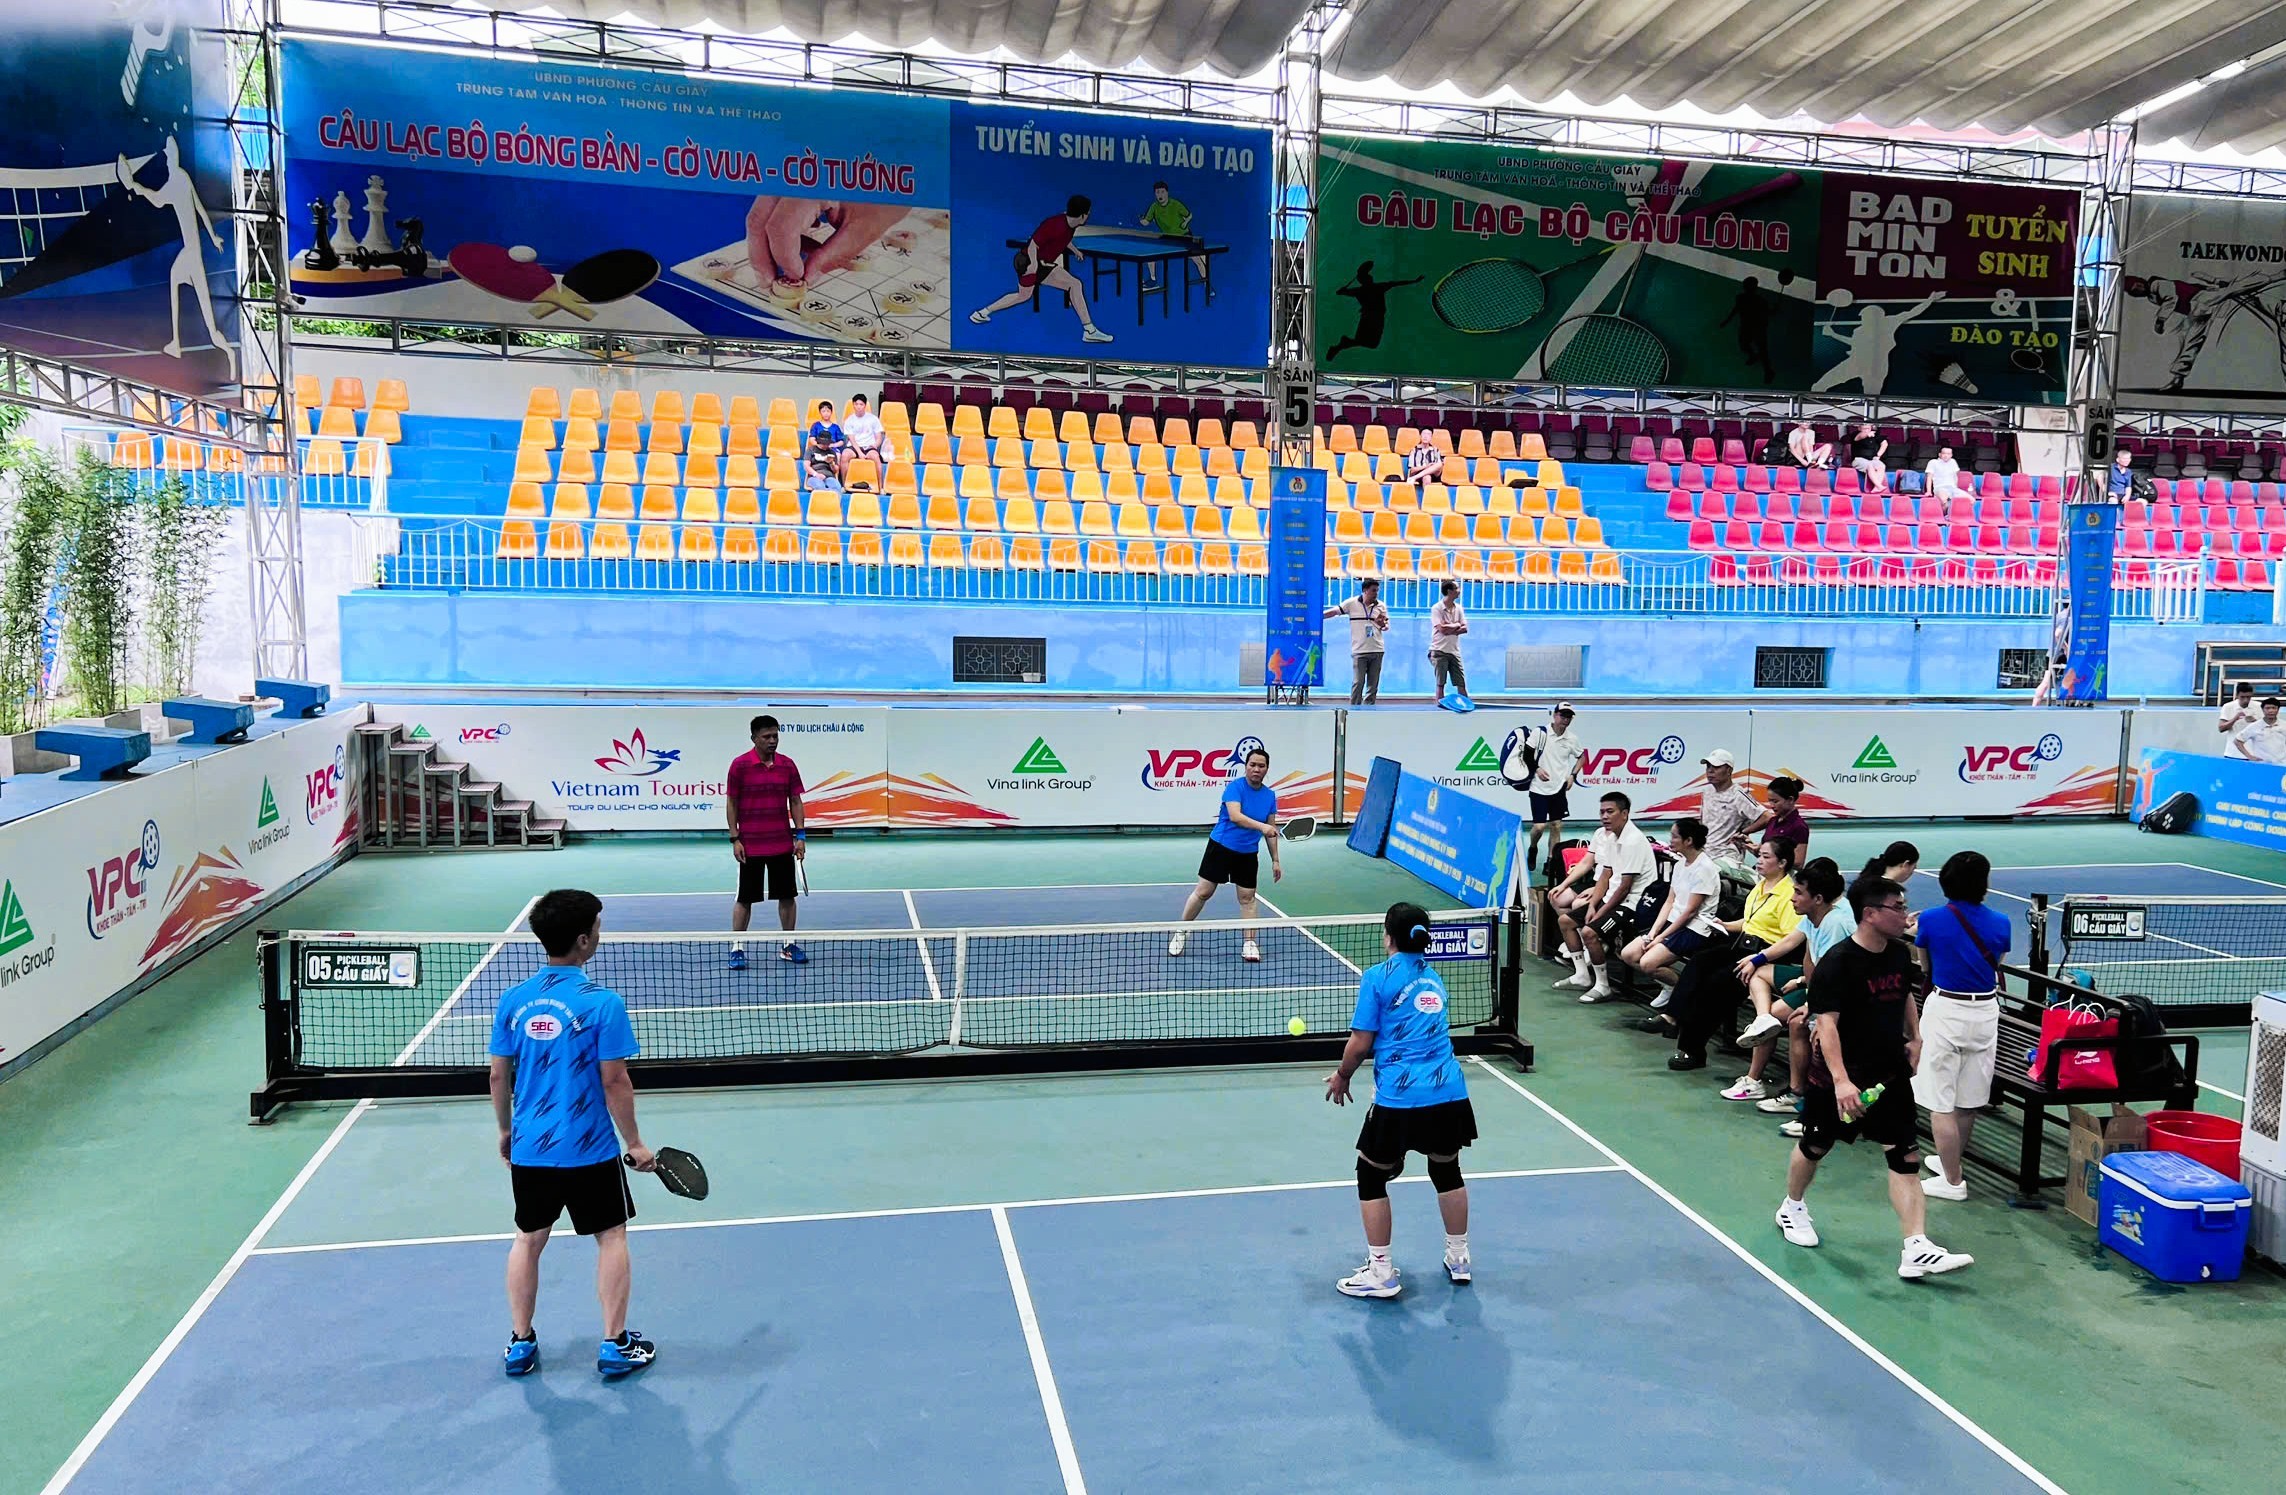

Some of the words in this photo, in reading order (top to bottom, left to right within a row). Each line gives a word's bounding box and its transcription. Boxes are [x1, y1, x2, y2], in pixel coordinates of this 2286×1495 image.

[534, 71, 573, 85] UBND
[455, 82, 504, 96] TRUNG
[672, 102, 692, 114] TIN
[318, 108, 379, 150] CÂU
[385, 121, 441, 161] LẠC
[446, 119, 489, 166] BỘ
[495, 122, 575, 168] BÓNG
[581, 129, 640, 174] BÀN
[663, 136, 701, 178] CỜ
[705, 149, 762, 183] VUA
[783, 147, 819, 188] CỜ
[823, 152, 915, 195] TƯỚNG
[975, 119, 1050, 156] TUYỂN
[1058, 132, 1115, 162] SINH
[1122, 134, 1152, 165] VÀ
[1158, 137, 1205, 169] ĐÀO
[1212, 145, 1254, 177] TẠO
[1497, 156, 1529, 169] UBND
[1434, 168, 1472, 182] TRUNG
[1609, 180, 1627, 192] TIN
[1848, 190, 1953, 224] BAD
[1357, 190, 1438, 230] CÂU
[1451, 199, 1526, 240] LẠC
[1538, 202, 1591, 246] BỘ
[1604, 202, 1681, 245] CẦU
[1693, 212, 1790, 253] LÔNG
[1966, 204, 2068, 244] TUYỂN
[1846, 220, 1937, 253] MIN
[1845, 249, 1947, 279] TON
[1977, 250, 2049, 278] SINH
[2179, 241, 2286, 263] TAEKWOND
[1990, 287, 2021, 317] &
[1950, 323, 2003, 345] ĐÀO
[2009, 330, 2059, 352] TẠO
[1283, 367, 1313, 382] SÂN
[1285, 386, 1309, 427] 5
[2088, 406, 2114, 419] SÂN
[2088, 422, 2109, 460] 6
[461, 728, 497, 740] VPC
[786, 723, 795, 732] TY
[796, 723, 806, 732] DU
[1147, 749, 1233, 778] VPC
[1583, 748, 1656, 776] VPC
[1964, 746, 2035, 771] VPC
[306, 764, 335, 809] VPC
[551, 780, 640, 797] Vietnam
[648, 780, 728, 797] Tourist
[986, 778, 1019, 790] Vina
[1021, 778, 1045, 790] link
[1048, 777, 1092, 792] Group
[1463, 776, 1485, 786] link
[1487, 776, 1512, 786] Gro
[1830, 772, 1857, 784] Vina
[1858, 773, 1879, 783] link
[1881, 772, 1917, 785] Group
[638, 803, 659, 811] CHO
[248, 839, 262, 855] Vina
[262, 833, 273, 848] link
[272, 825, 290, 843] Group
[87, 847, 141, 917] VPC
[2073, 913, 2088, 934] 06
[2091, 913, 2125, 921] PICKLEBALL
[0, 961, 21, 988] link
[21, 946, 55, 975] Group
[308, 955, 331, 980] 05
[336, 955, 387, 965] PICKLEBALL
